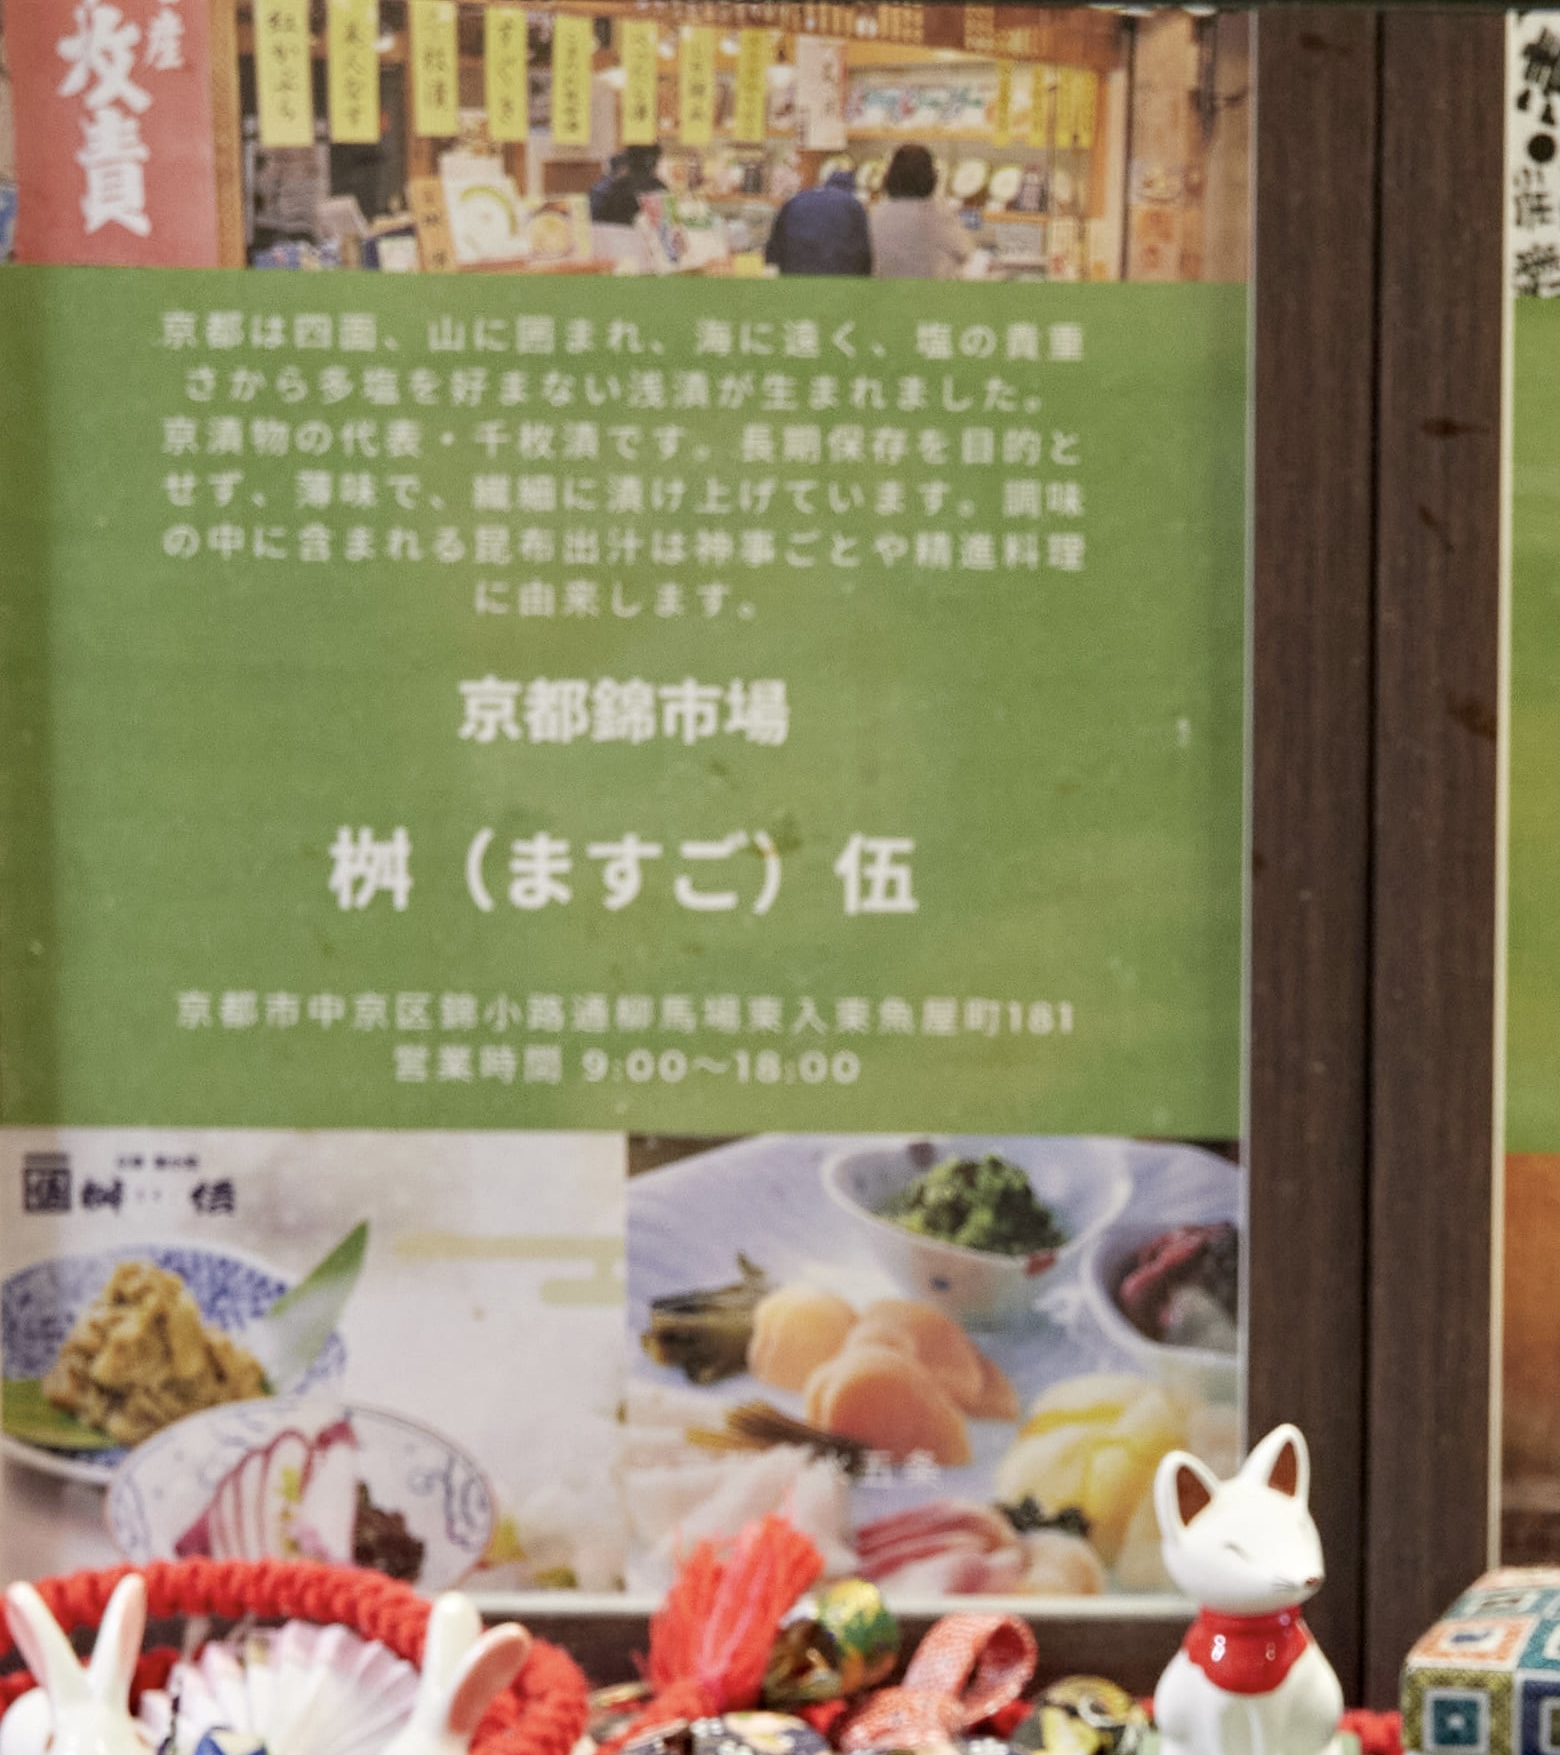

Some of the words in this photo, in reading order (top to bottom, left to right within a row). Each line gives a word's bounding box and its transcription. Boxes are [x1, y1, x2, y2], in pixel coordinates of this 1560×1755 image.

[185, 364, 1042, 413] さから多塩を好まない浅漬が生まれました。
[161, 415, 1082, 466] 京漬物の代表・千枚漬です。長期保存を目的と
[161, 521, 1086, 572] の中に含まれる昆布出汁は神事ごとや精進料理
[475, 578, 756, 620] に由来します。
[457, 675, 791, 746] 京都錦市場
[393, 1045, 564, 1086] 営業時間
